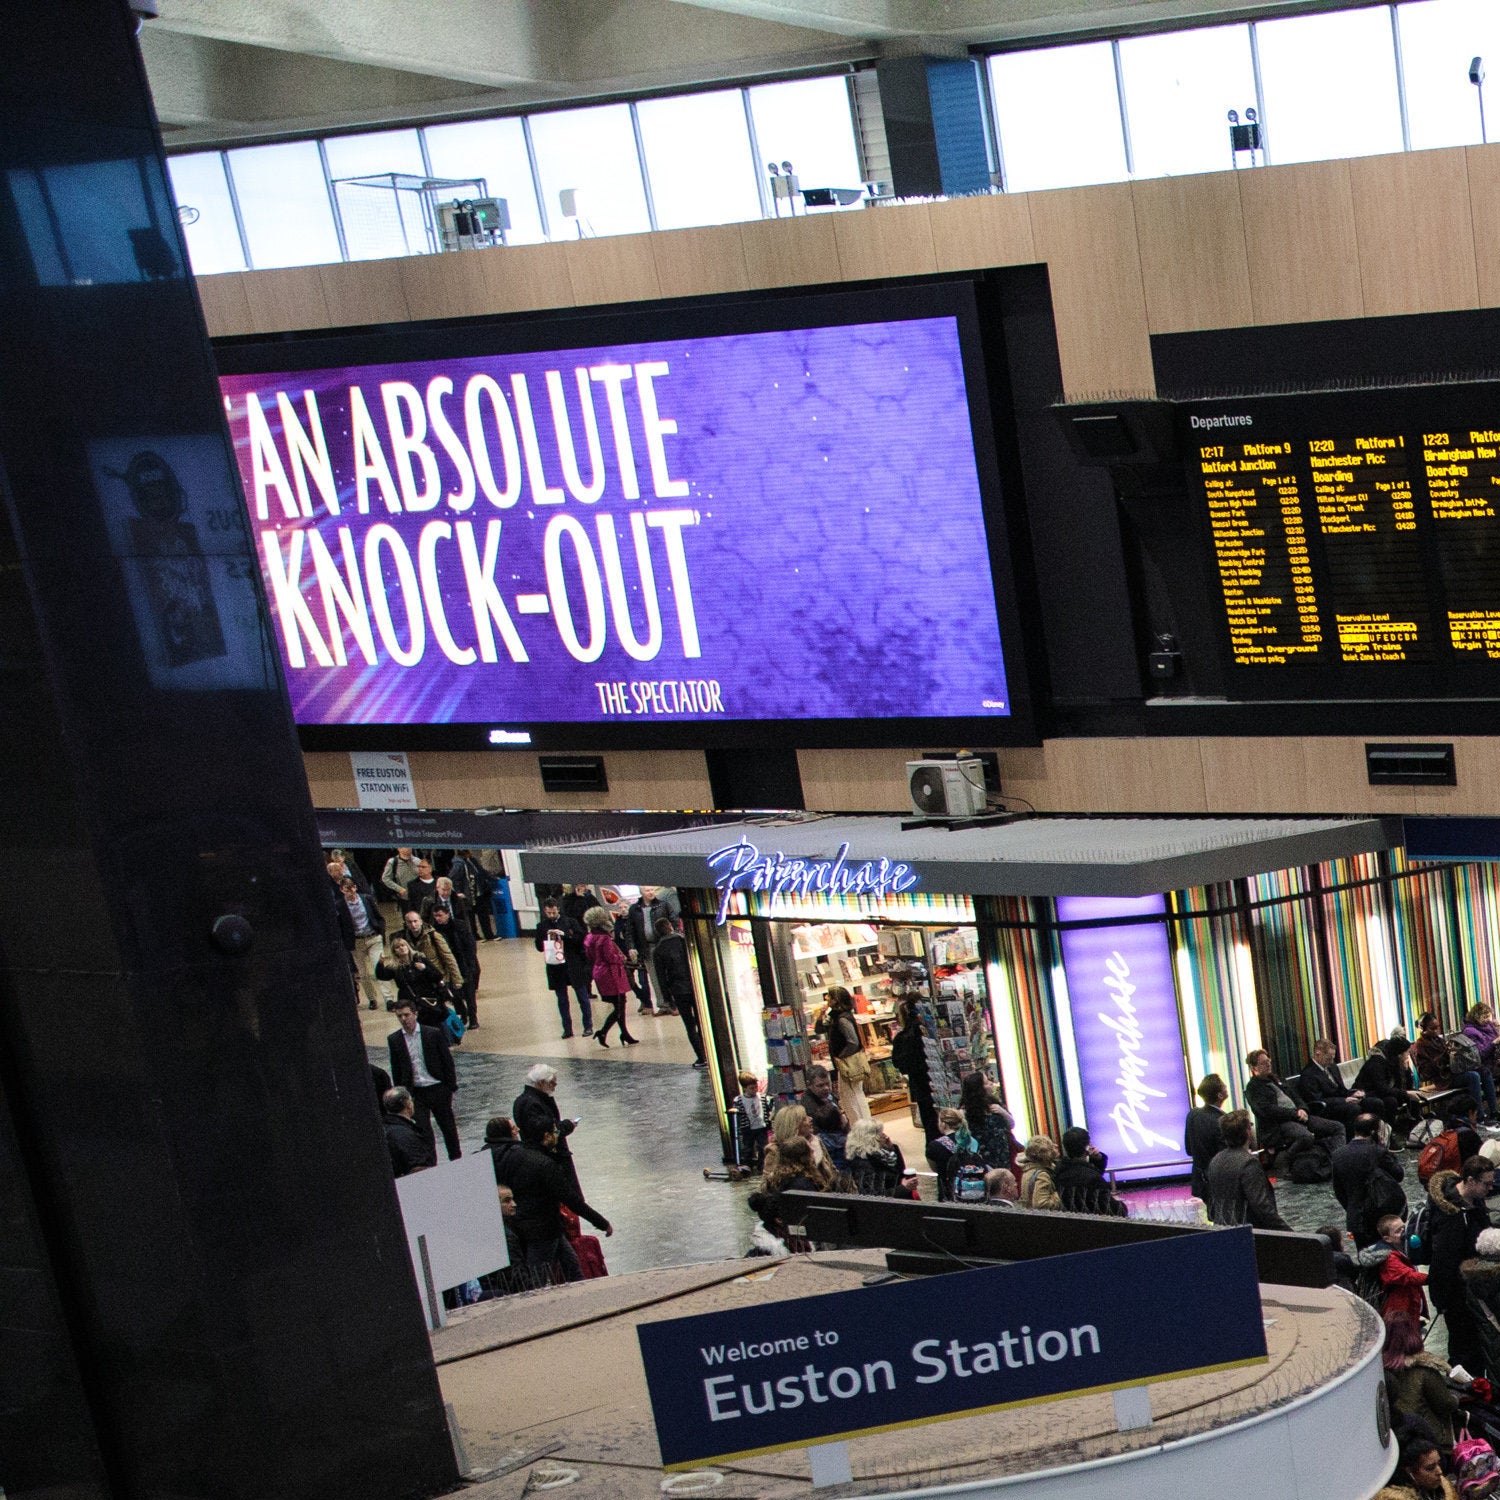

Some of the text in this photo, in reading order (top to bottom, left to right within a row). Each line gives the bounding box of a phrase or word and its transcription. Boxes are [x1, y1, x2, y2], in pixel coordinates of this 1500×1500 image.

[1191, 415, 1253, 430] Departures
[350, 360, 690, 512] ABSOLUTE
[1309, 436, 1404, 452] 12:20 Platform 1
[1200, 443, 1291, 458] 12:17 Platform 9
[1202, 460, 1276, 474] Watford Junction
[1311, 453, 1386, 468] Manchester Picc
[596, 680, 725, 715] THE SPECTATOR
[357, 768, 406, 778] FREE EUSTON
[361, 783, 409, 792] STATION WiFi
[707, 834, 919, 927] Paperchase
[1098, 950, 1180, 1154] Paperchase
[702, 1327, 840, 1366] Welcome to
[703, 1324, 1101, 1423] Euston Station
